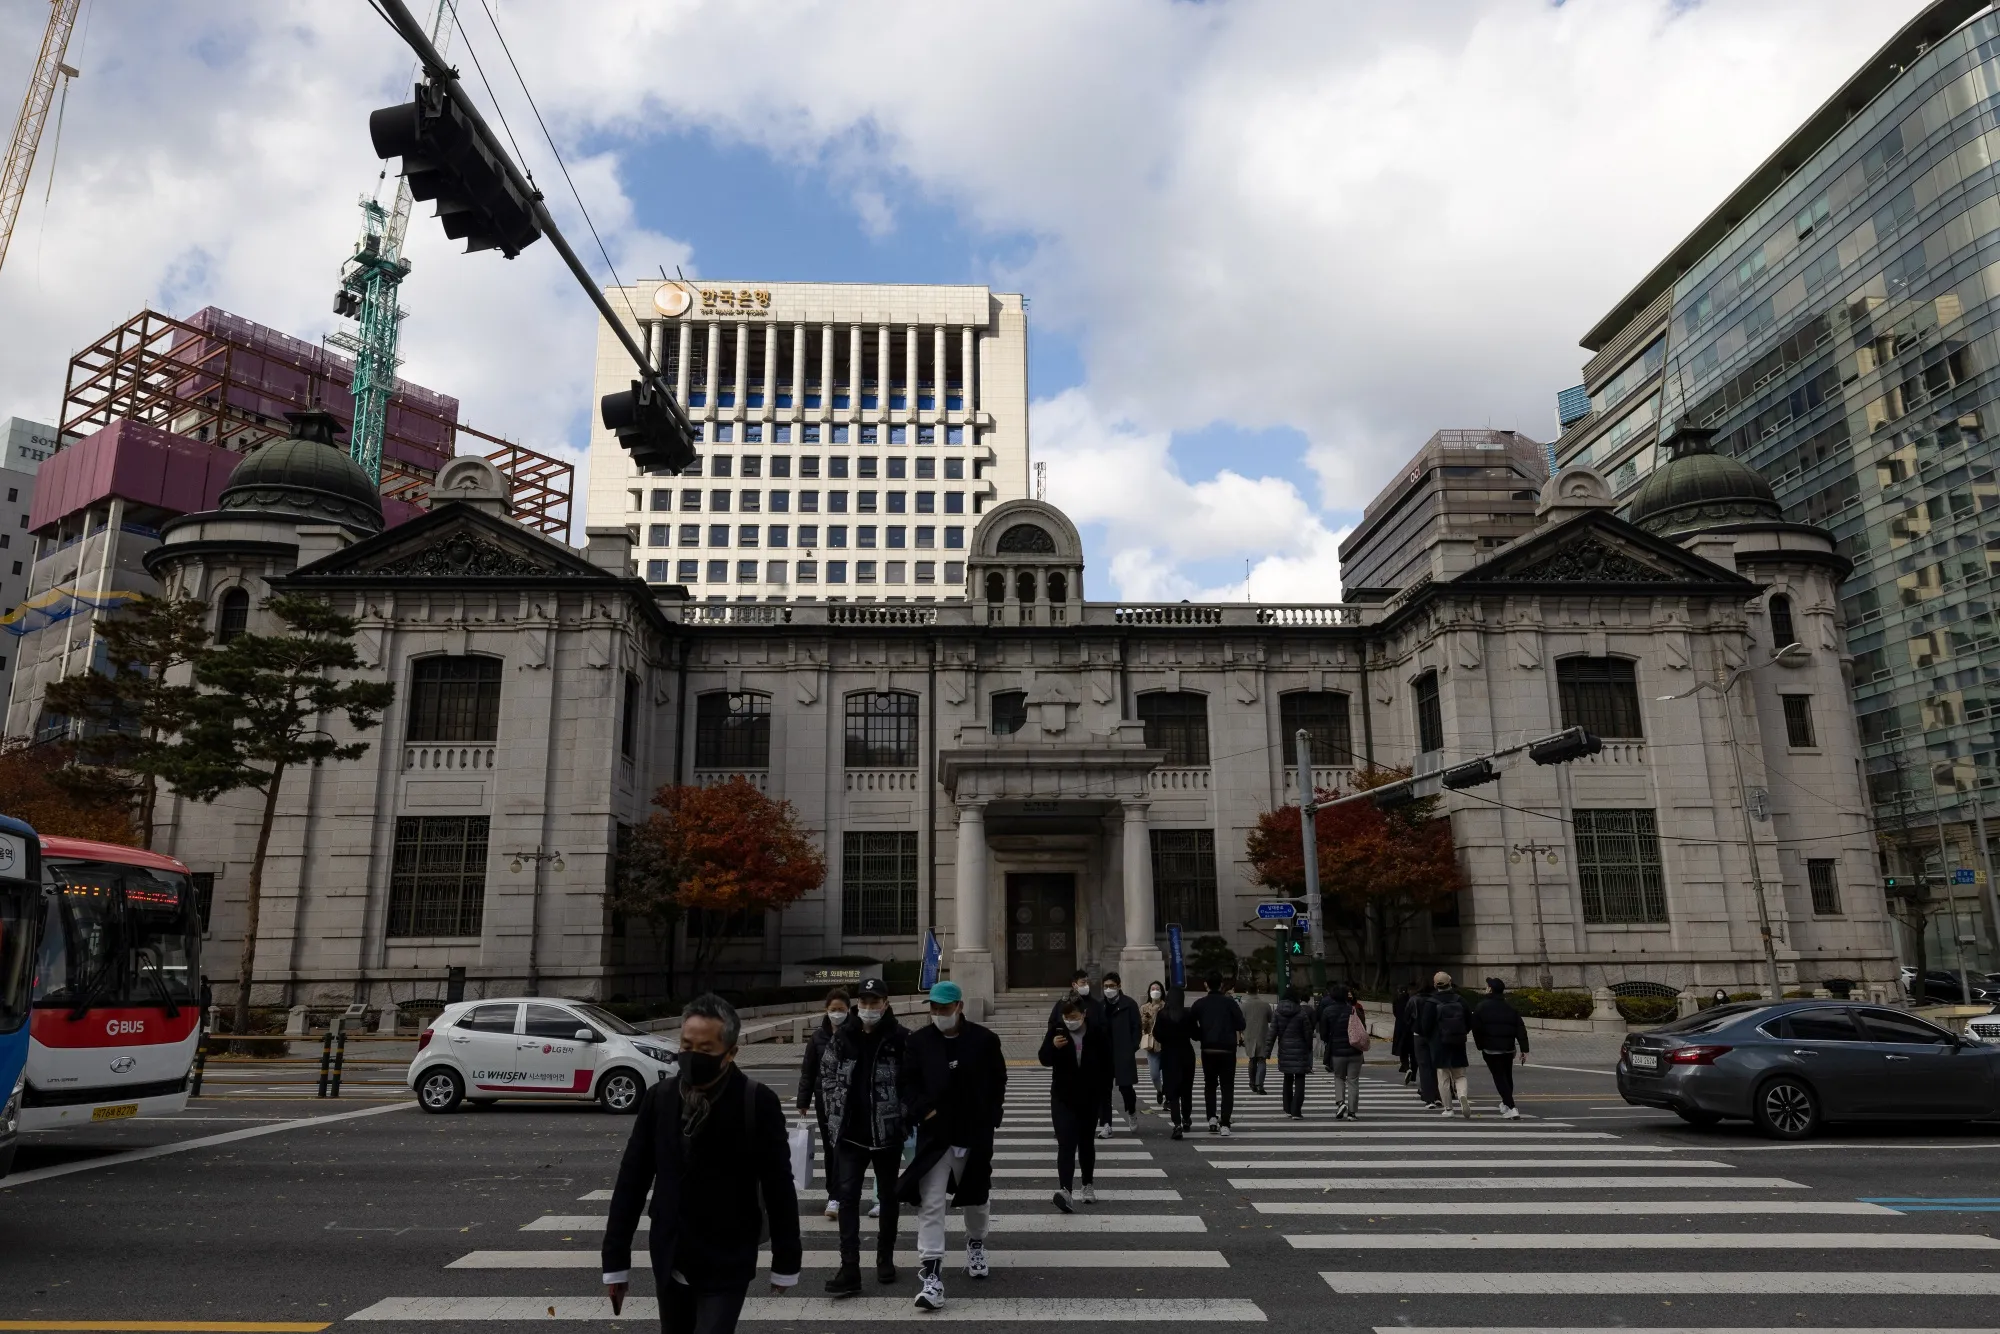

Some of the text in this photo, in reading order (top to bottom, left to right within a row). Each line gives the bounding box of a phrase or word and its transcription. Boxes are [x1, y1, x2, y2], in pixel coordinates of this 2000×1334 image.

[700, 289, 771, 308] 한국은행
[865, 979, 875, 990] S
[472, 1070, 565, 1083] LG WHISEN 시스템에어컨
